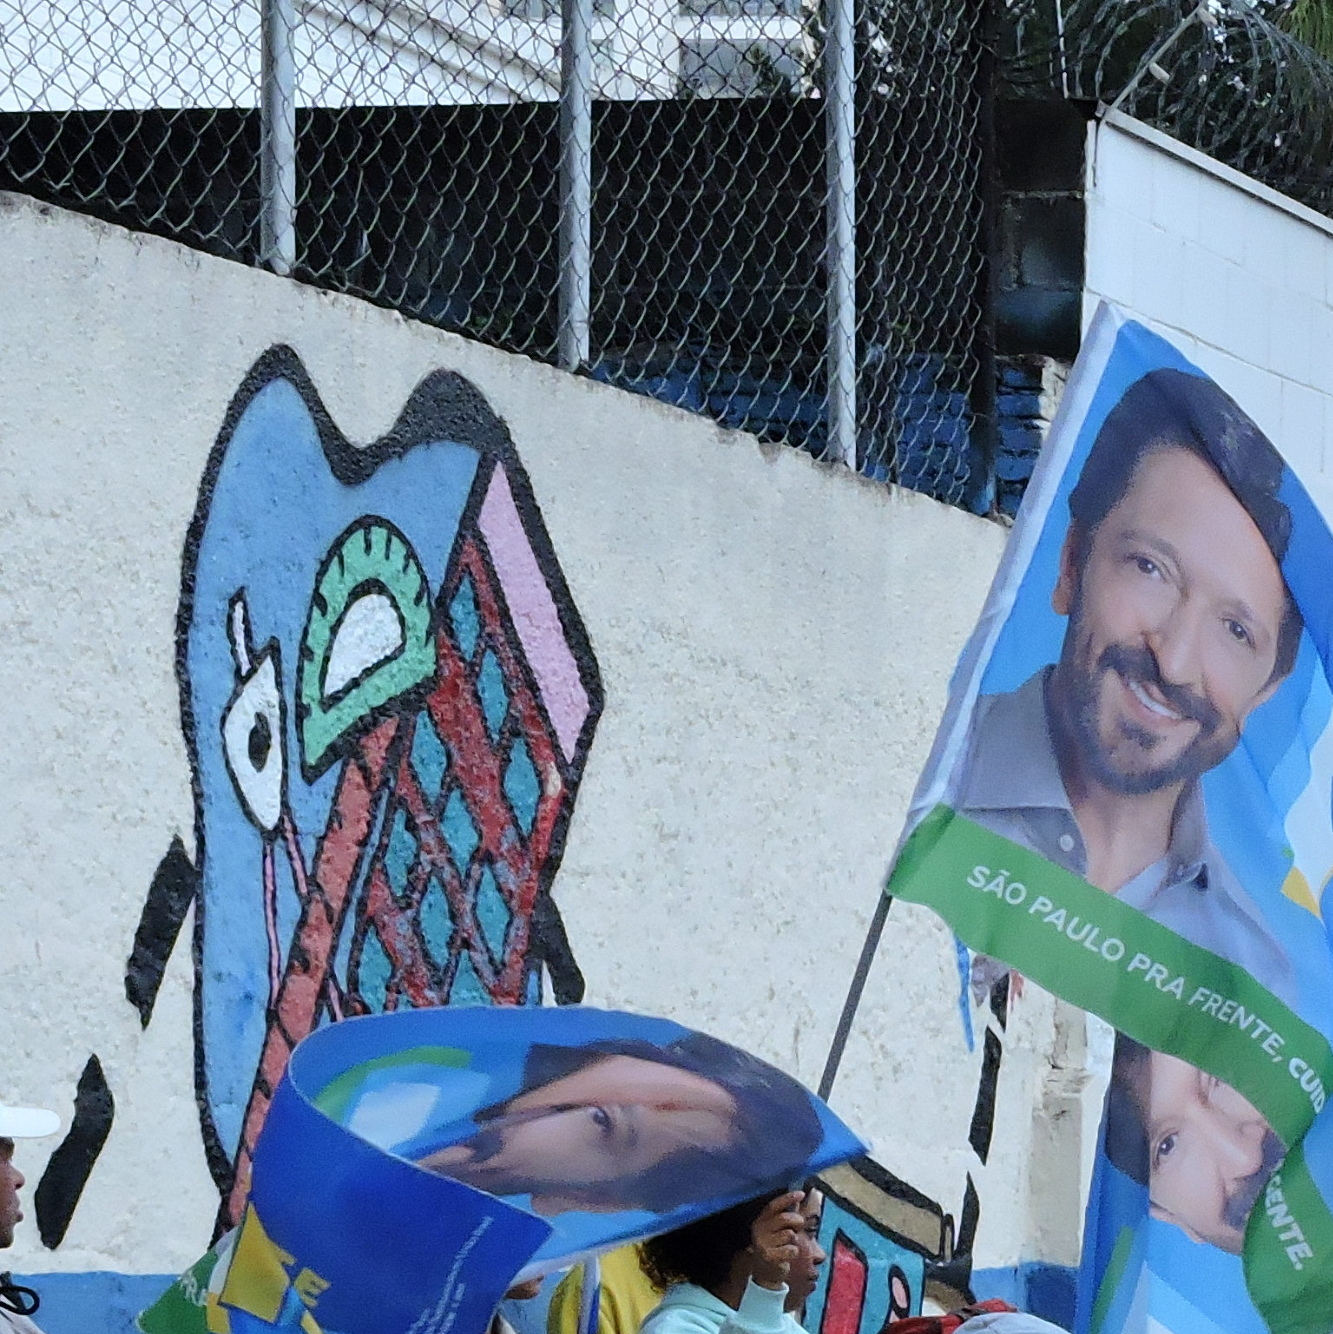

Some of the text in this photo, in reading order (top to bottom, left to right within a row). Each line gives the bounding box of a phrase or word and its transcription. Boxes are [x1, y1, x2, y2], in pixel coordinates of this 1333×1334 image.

[966, 864, 1027, 906] SÃO
[1029, 895, 1125, 962] PAULO
[1127, 952, 1186, 1000] PRA
[1188, 986, 1285, 1063] FRENTE,
